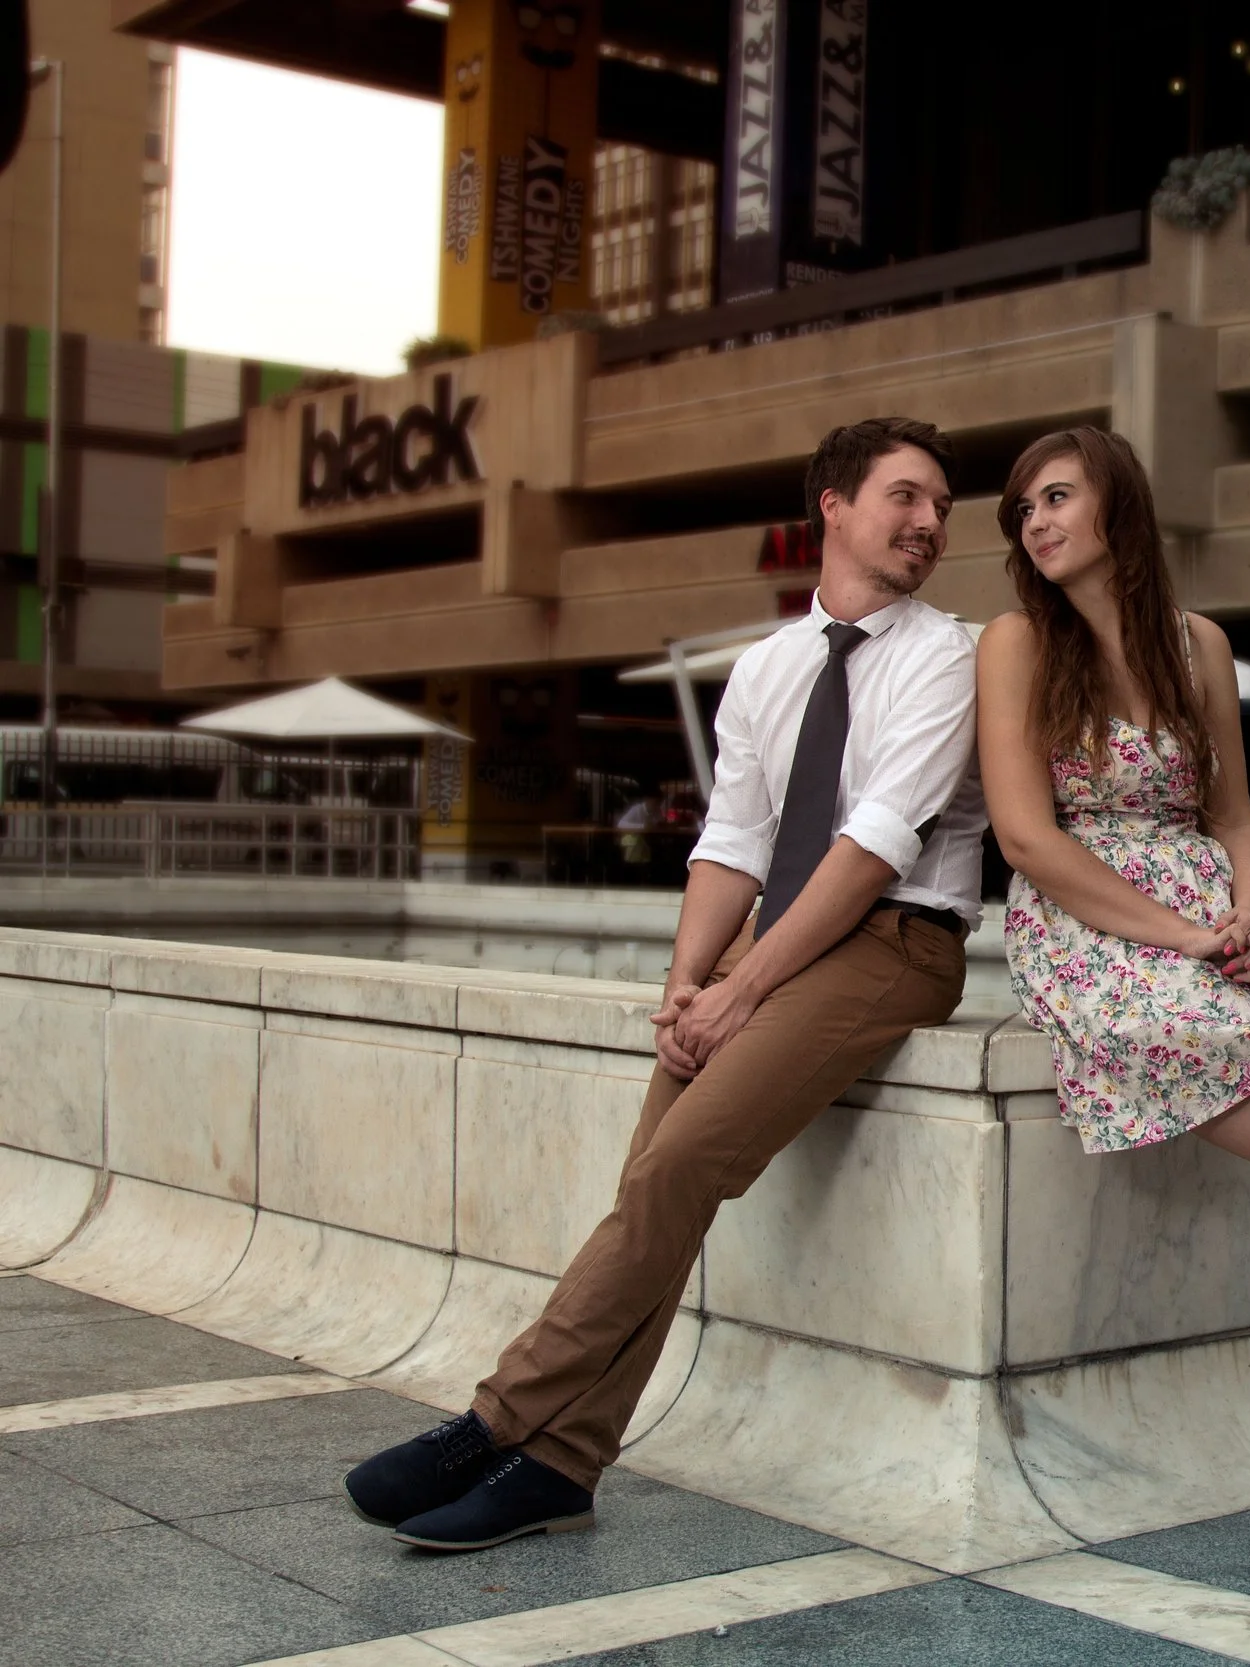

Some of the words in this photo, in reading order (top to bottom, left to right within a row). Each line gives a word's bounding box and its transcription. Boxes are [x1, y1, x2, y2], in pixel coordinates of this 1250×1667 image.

[455, 150, 476, 265] COMEDY
[491, 154, 520, 280] TSHWANE
[521, 136, 566, 314] COMEDY
[555, 179, 585, 284] NIGHTS
[299, 373, 482, 508] black
